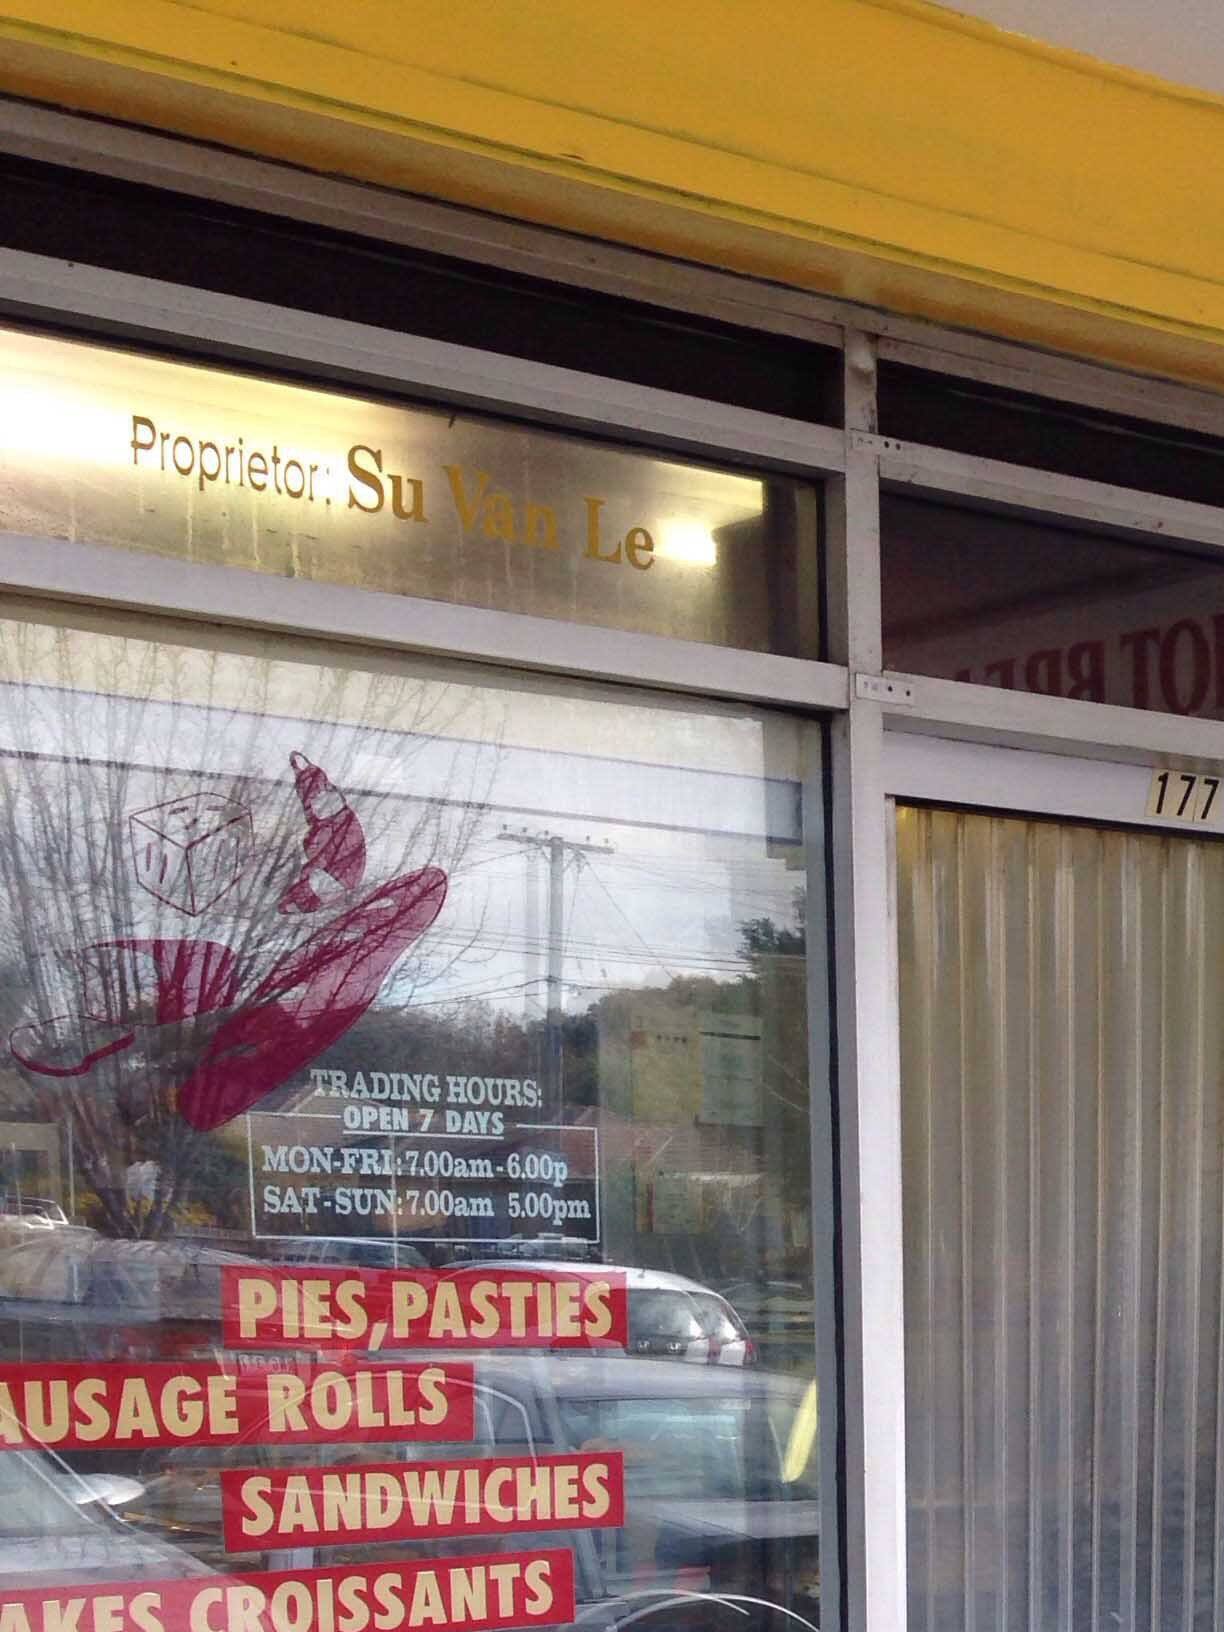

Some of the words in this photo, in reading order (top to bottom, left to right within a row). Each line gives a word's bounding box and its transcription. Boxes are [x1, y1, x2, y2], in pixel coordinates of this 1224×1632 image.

[131, 415, 332, 507] Proprietor:
[347, 443, 426, 525] Su
[443, 464, 560, 552] Van
[583, 496, 655, 570] Le
[1155, 770, 1221, 822] 177
[310, 1069, 440, 1102] TRADING
[446, 1075, 543, 1107] HOURS:
[344, 1106, 409, 1132] OPEN
[420, 1109, 434, 1133] 7
[446, 1110, 505, 1135] DAYS
[508, 1191, 592, 1225] 5.00pm
[268, 1366, 449, 1433] ROLLS
[240, 1461, 611, 1539] SANDWICHES
